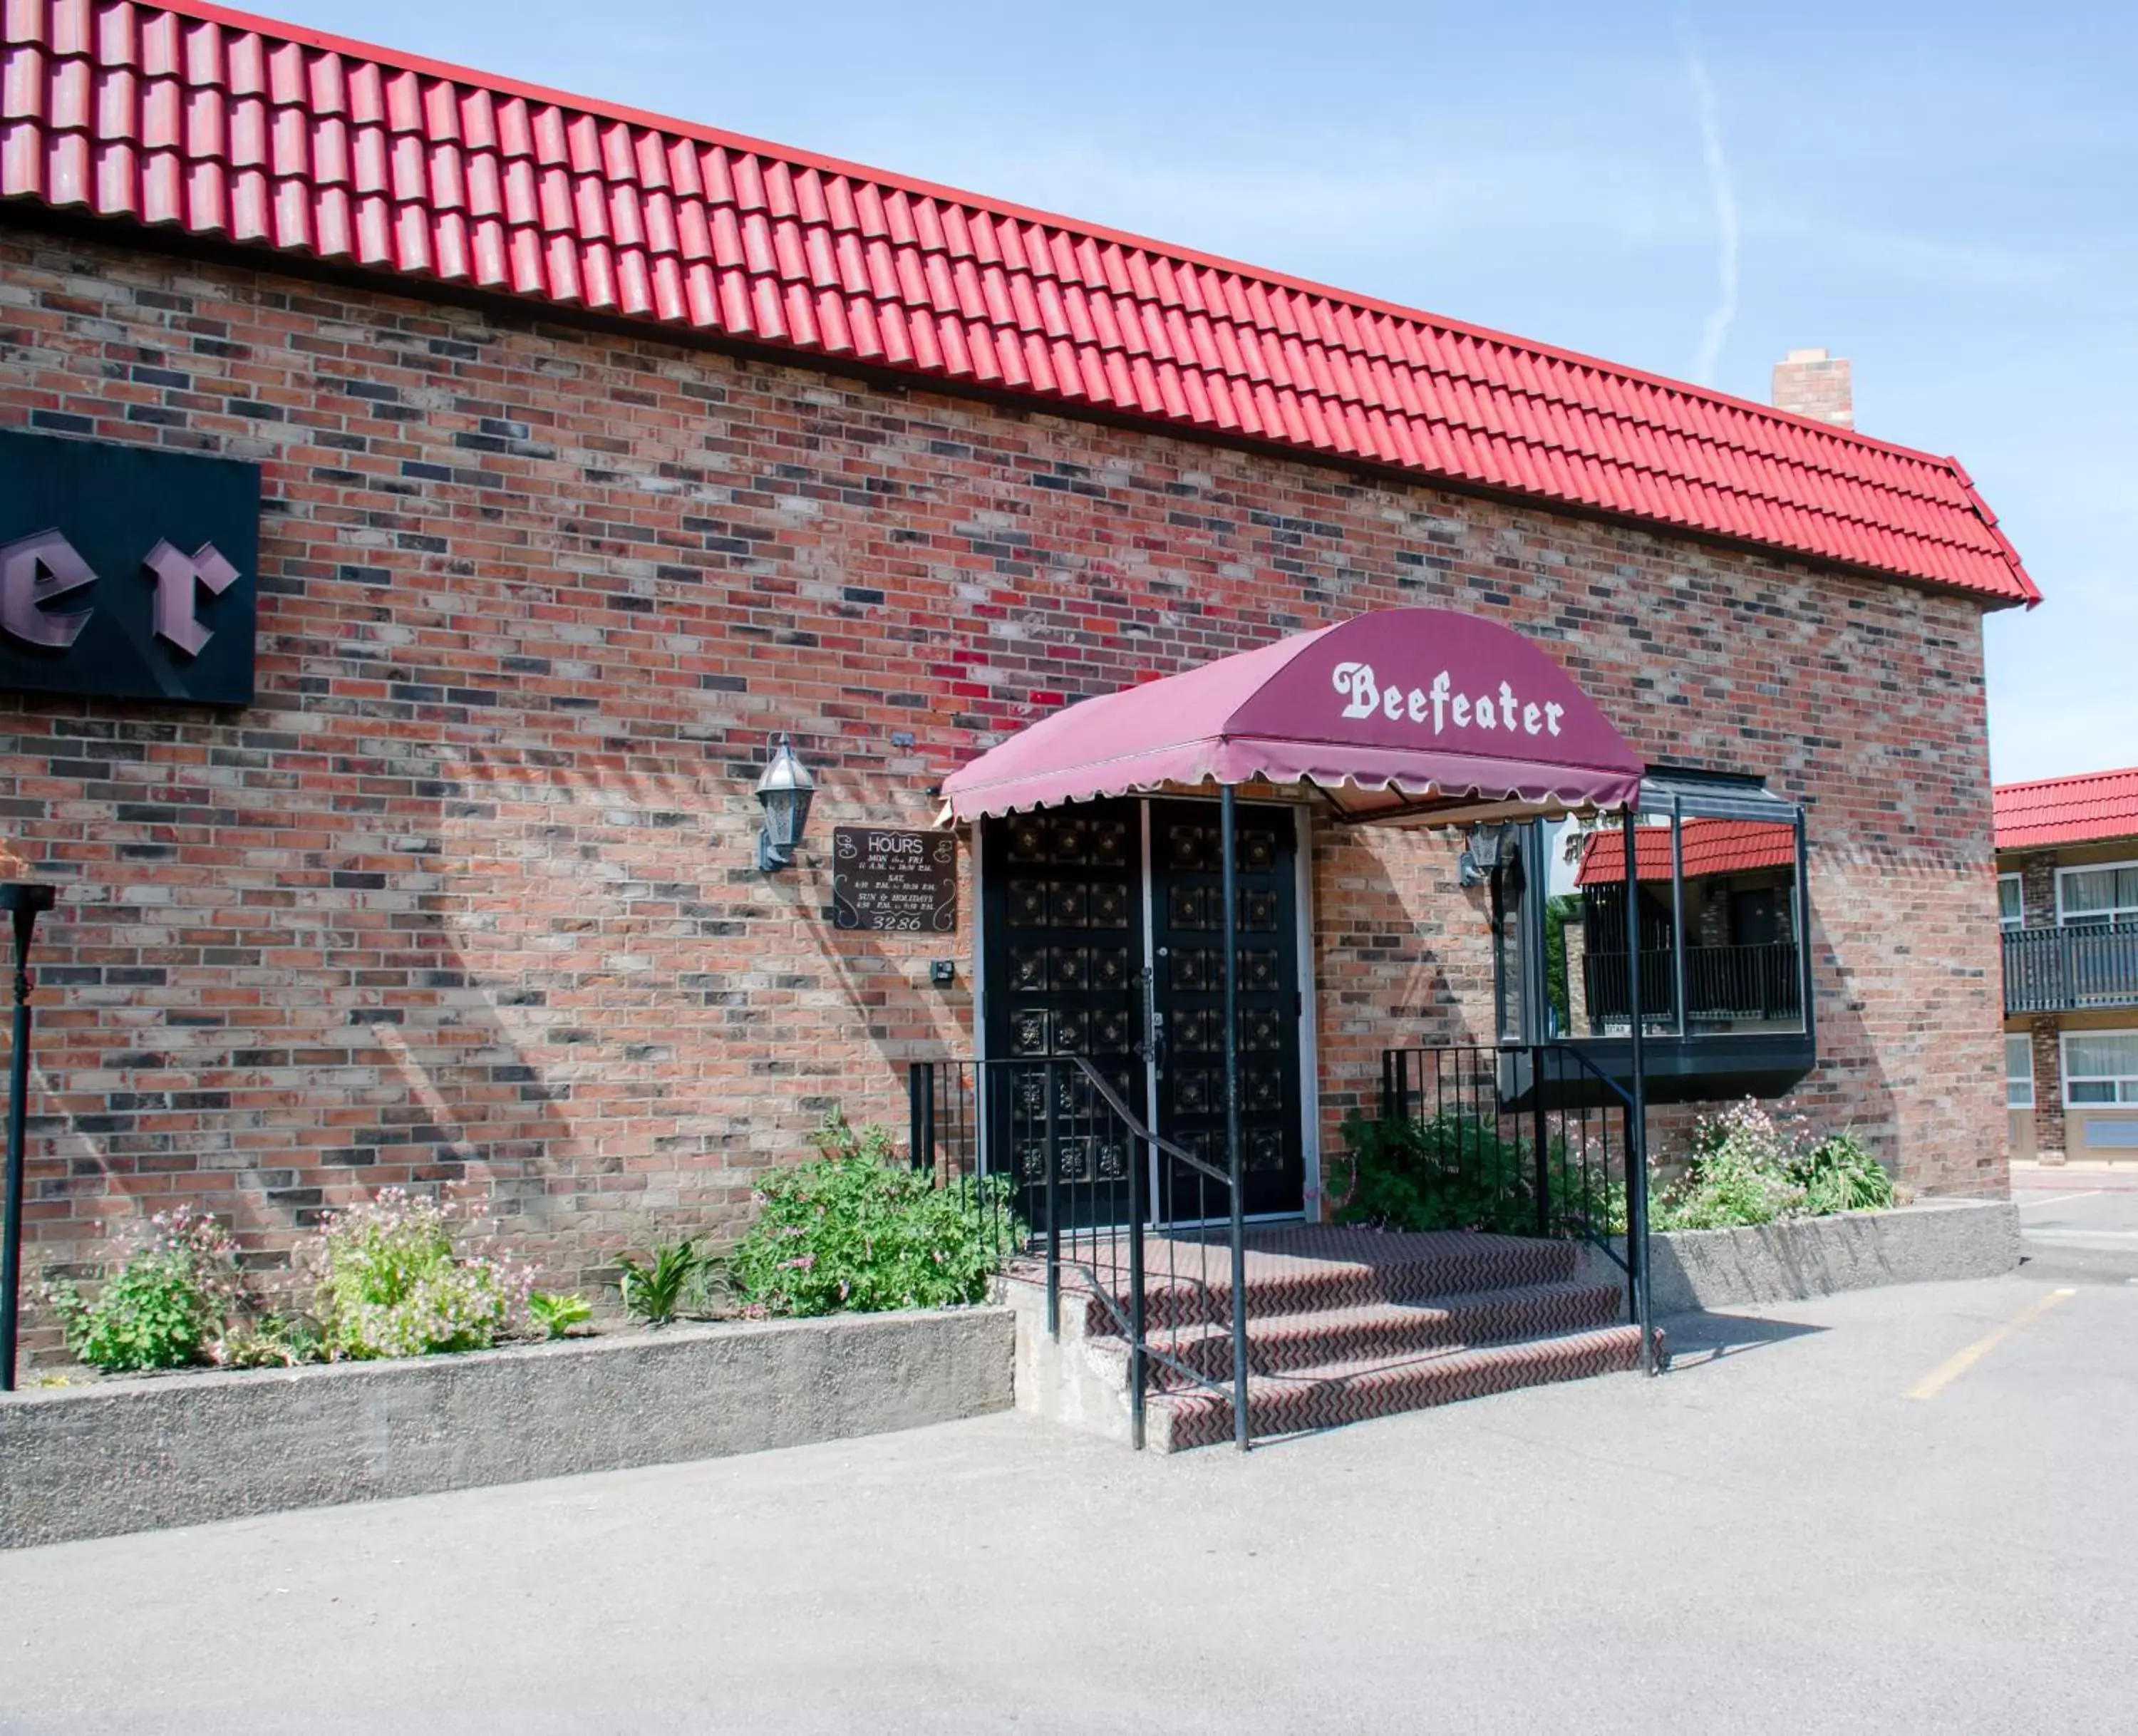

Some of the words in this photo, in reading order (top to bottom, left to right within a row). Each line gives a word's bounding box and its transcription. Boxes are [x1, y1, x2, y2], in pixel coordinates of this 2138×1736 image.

[0, 527, 242, 657] er
[1332, 662, 1564, 737] Beefeater
[868, 837, 923, 854] HOURS
[872, 916, 921, 931] 3286
